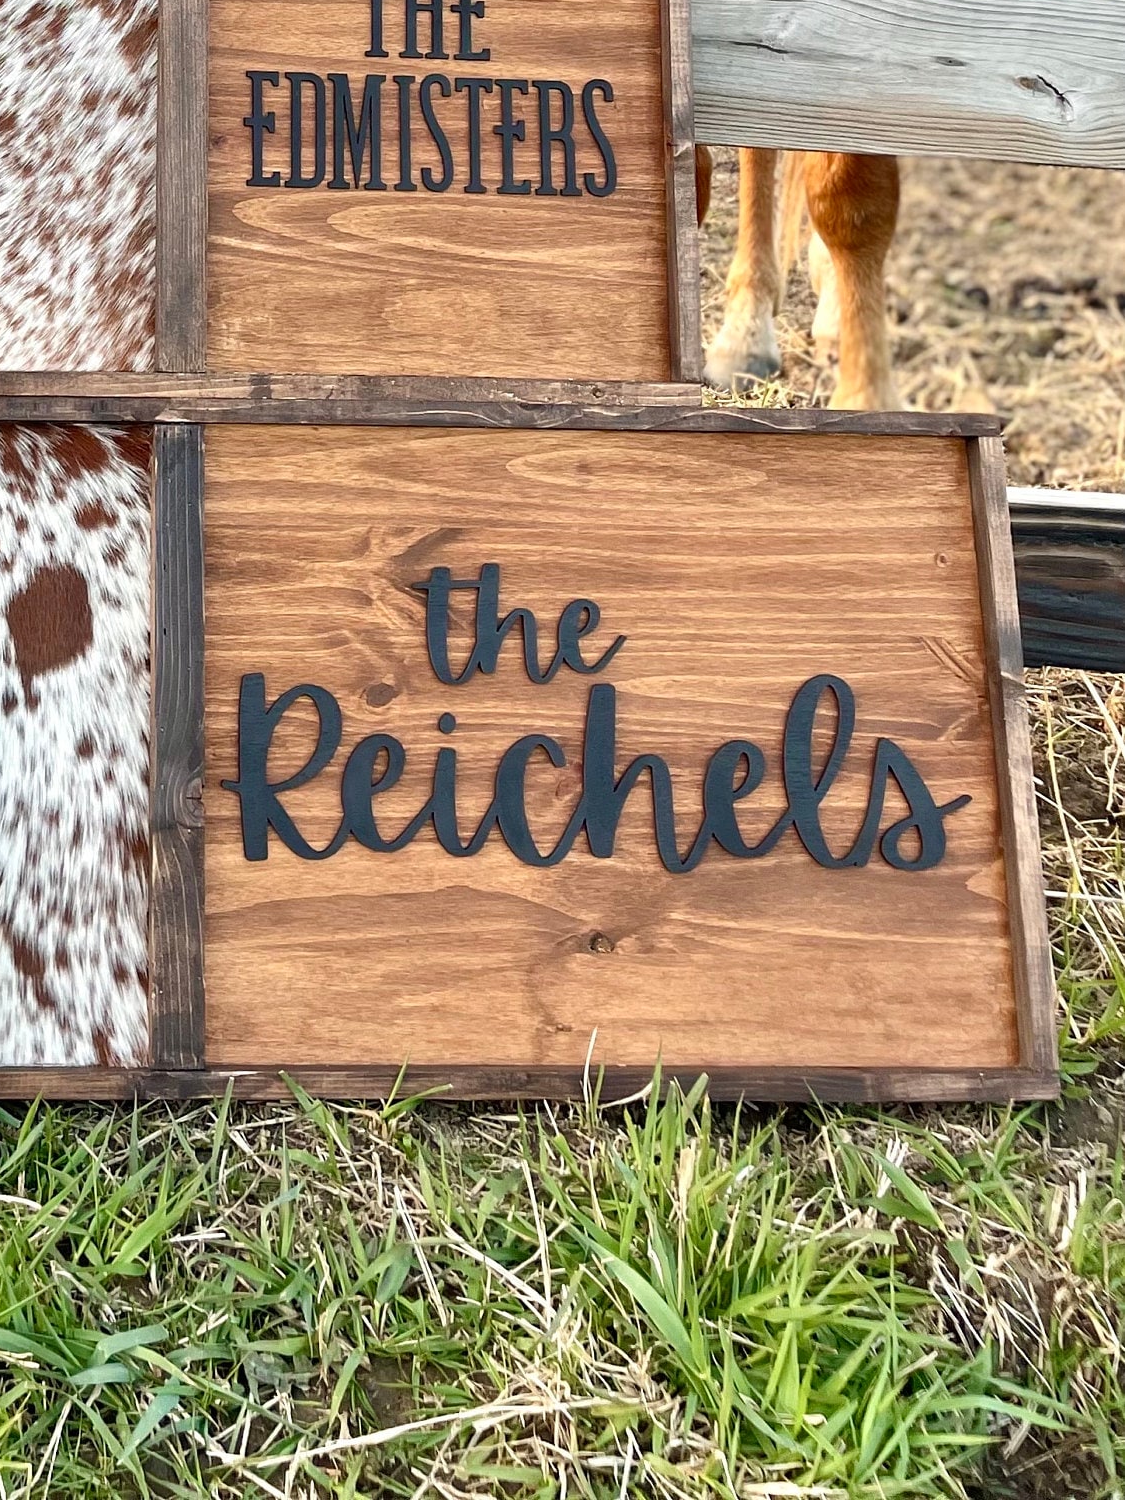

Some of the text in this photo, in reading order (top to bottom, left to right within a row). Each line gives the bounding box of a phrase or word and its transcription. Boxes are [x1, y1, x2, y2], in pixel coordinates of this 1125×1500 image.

[243, 71, 617, 198] EDMISTERS
[412, 562, 627, 684] the
[220, 672, 973, 873] Reichels
